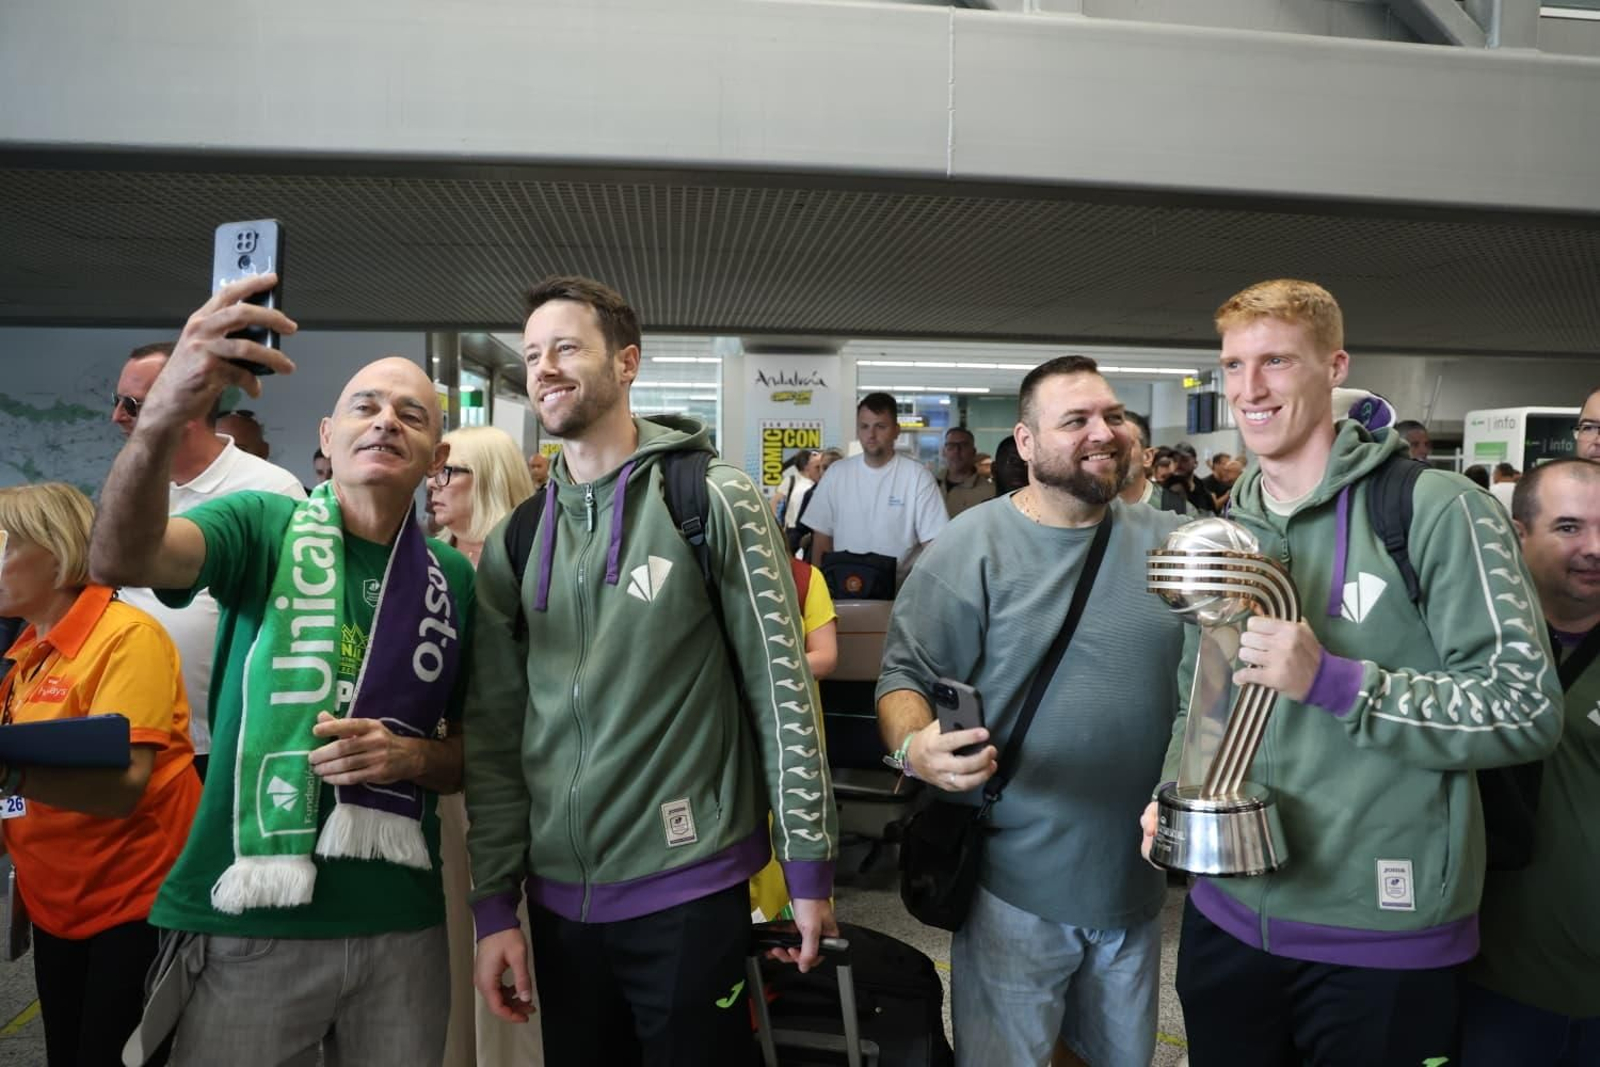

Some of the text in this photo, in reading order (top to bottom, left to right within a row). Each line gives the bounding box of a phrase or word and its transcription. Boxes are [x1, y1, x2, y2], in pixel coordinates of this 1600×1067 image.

[1494, 416, 1516, 429] info
[783, 429, 820, 448] CON
[1549, 439, 1573, 451] info
[763, 429, 783, 486] COMIC
[304, 764, 315, 824] Fundació
